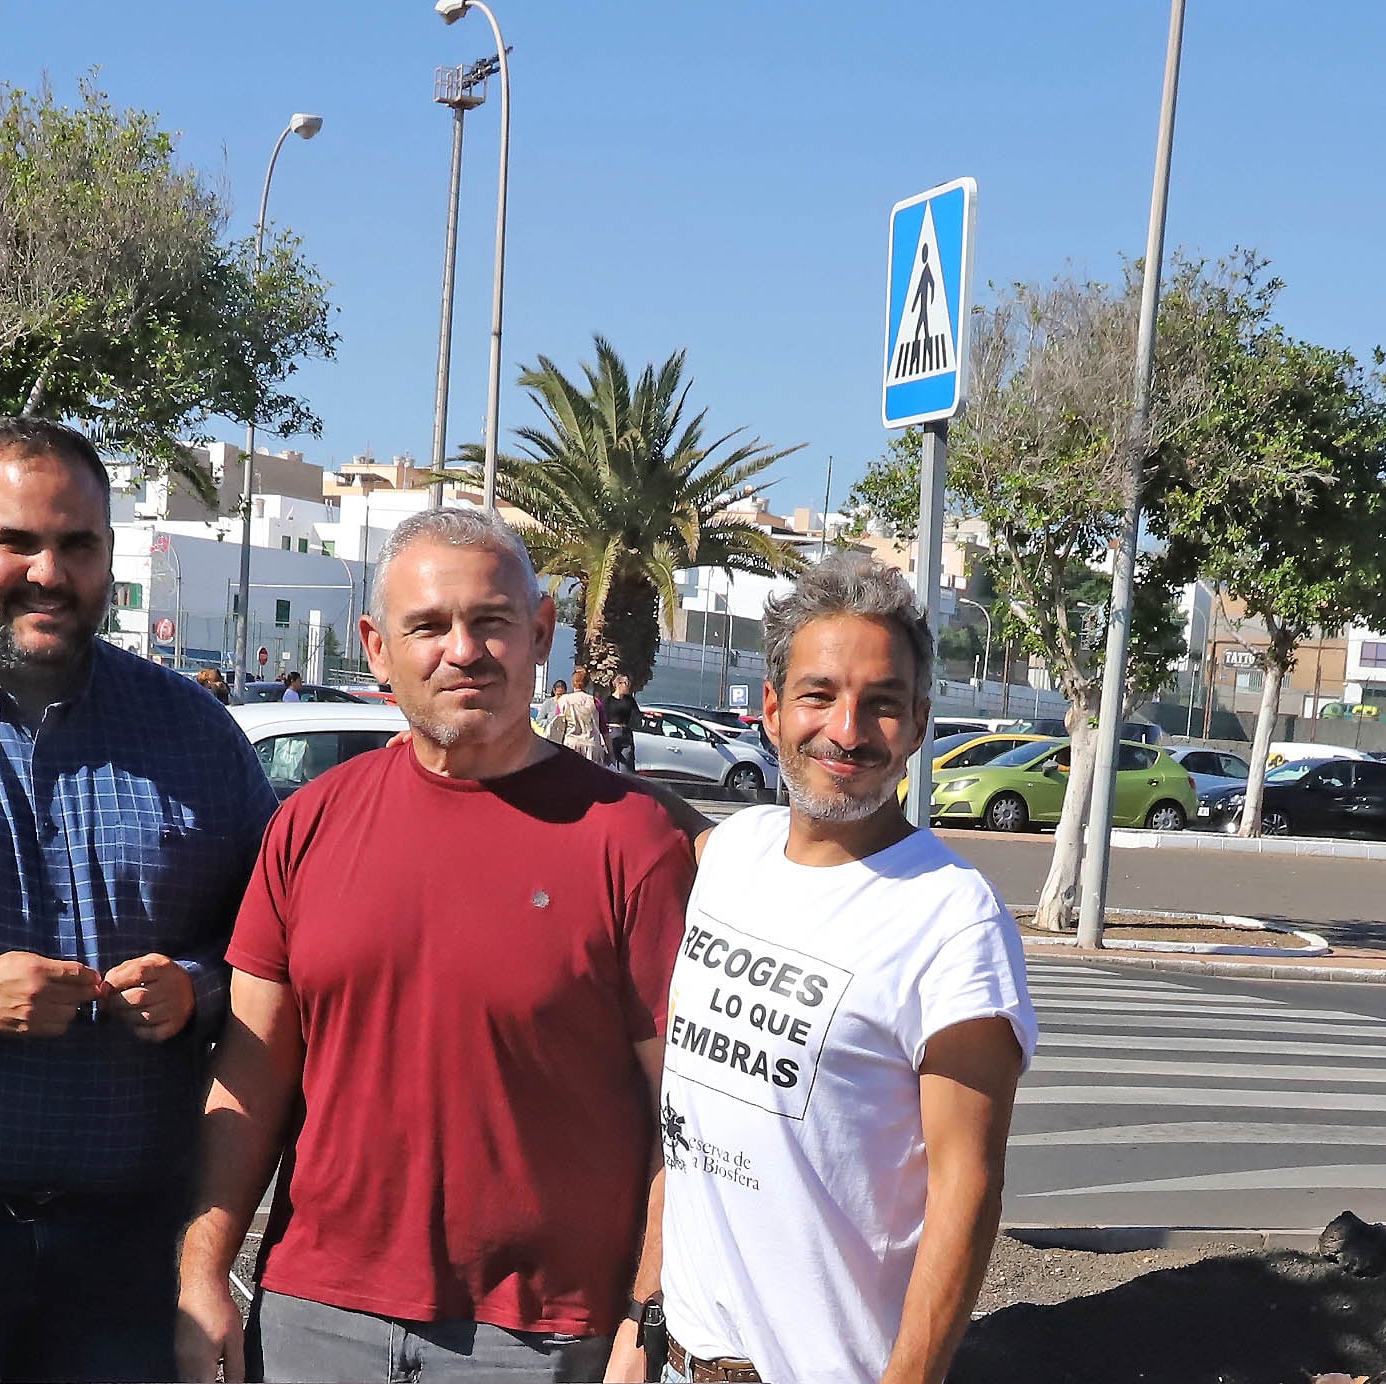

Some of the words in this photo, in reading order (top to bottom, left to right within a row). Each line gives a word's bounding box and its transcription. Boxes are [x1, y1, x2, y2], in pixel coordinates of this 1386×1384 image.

[1225, 651, 1259, 665] TATTO
[732, 688, 744, 702] P
[684, 925, 829, 1008] RECOGES
[709, 987, 743, 1019] LO
[749, 1003, 812, 1047] QUE
[669, 1015, 800, 1089] EMBRAS
[688, 1137, 730, 1162] eserva
[734, 1152, 750, 1170] de
[703, 1155, 760, 1190] Biosfera
